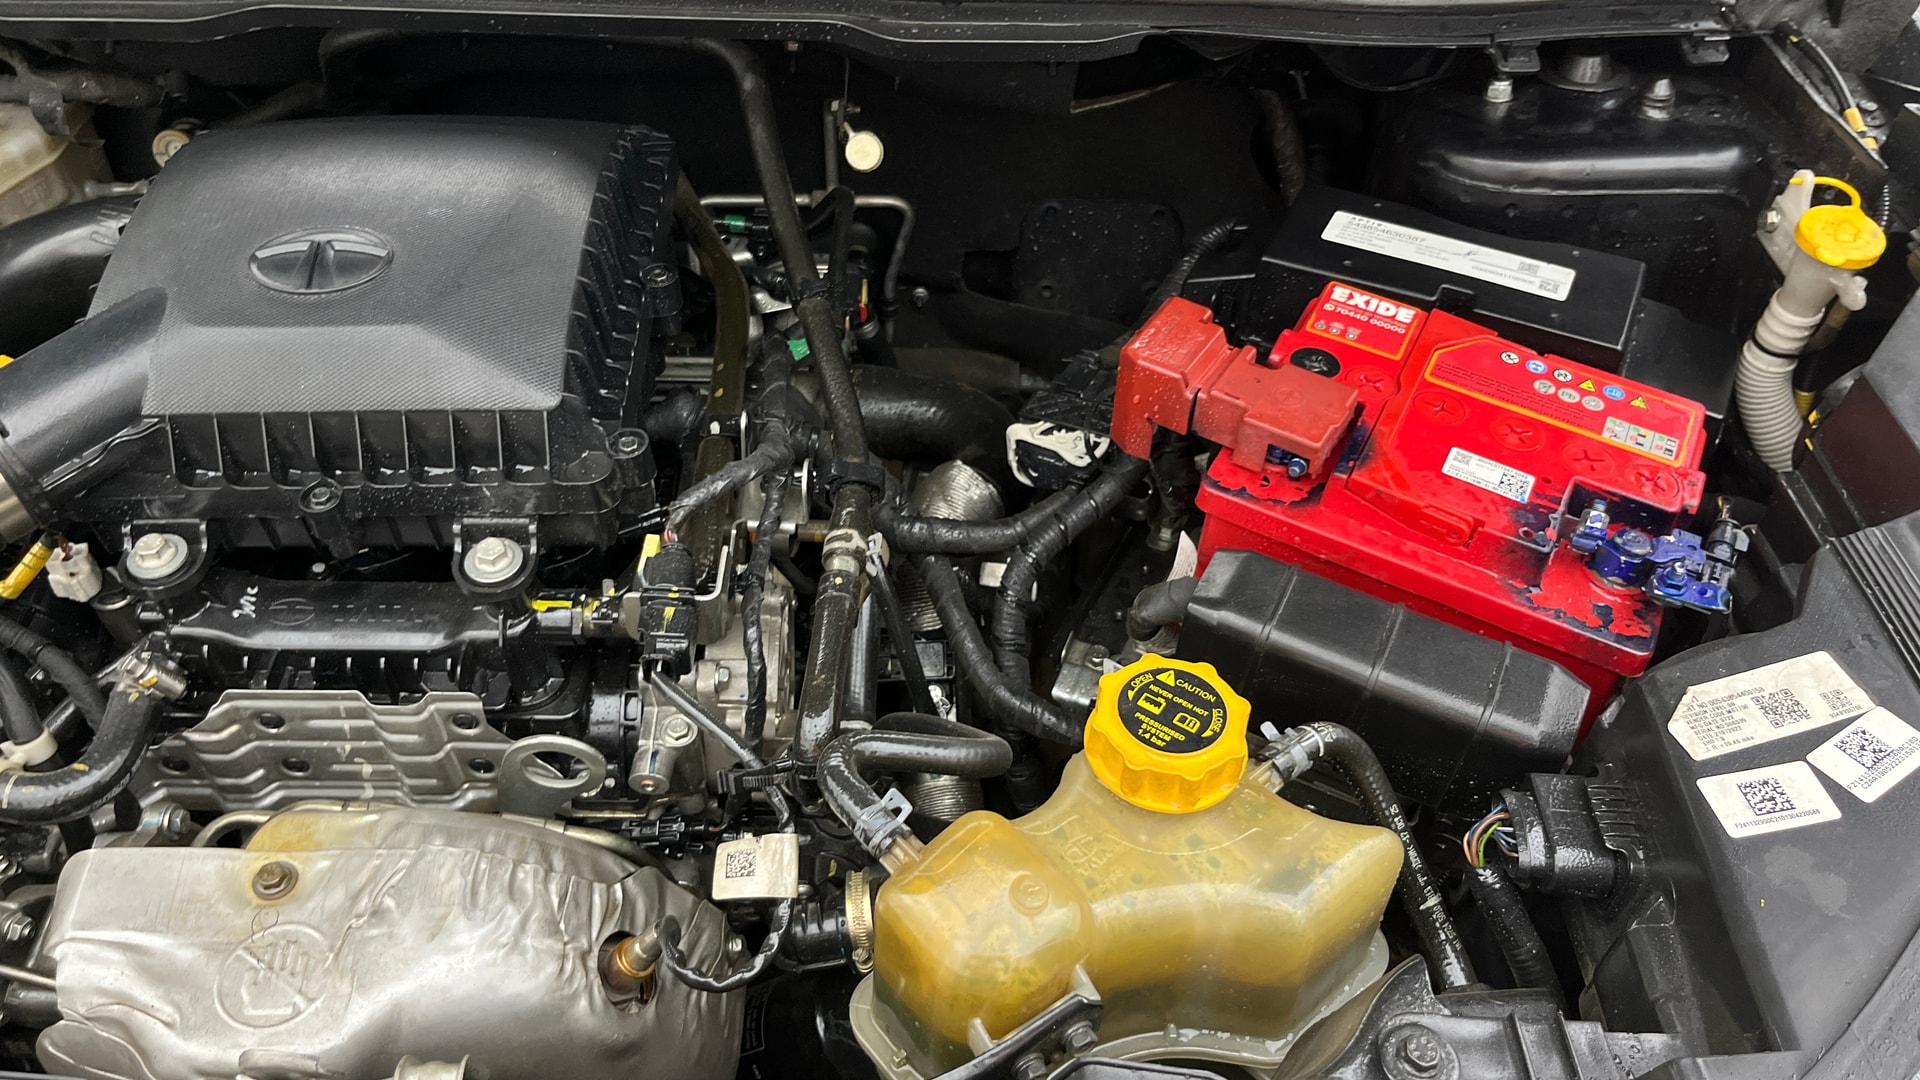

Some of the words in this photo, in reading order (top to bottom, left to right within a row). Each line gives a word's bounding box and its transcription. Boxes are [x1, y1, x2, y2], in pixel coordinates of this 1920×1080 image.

[1330, 285, 1416, 324] EXIDE
[1335, 306, 1368, 322] 70440
[1369, 318, 1406, 334] 00000
[1131, 673, 1154, 687] OPEN
[1176, 679, 1216, 703] CAUTION
[1149, 684, 1173, 699] NEVER
[1173, 696, 1193, 710] OPEN
[1193, 704, 1209, 718] HOT
[1134, 711, 1186, 741] PRESSURISED
[1140, 723, 1171, 742] SYSTEM
[1213, 708, 1224, 733] CLOSE
[1137, 729, 1150, 741] 1.4
[1150, 735, 1166, 747] bar
